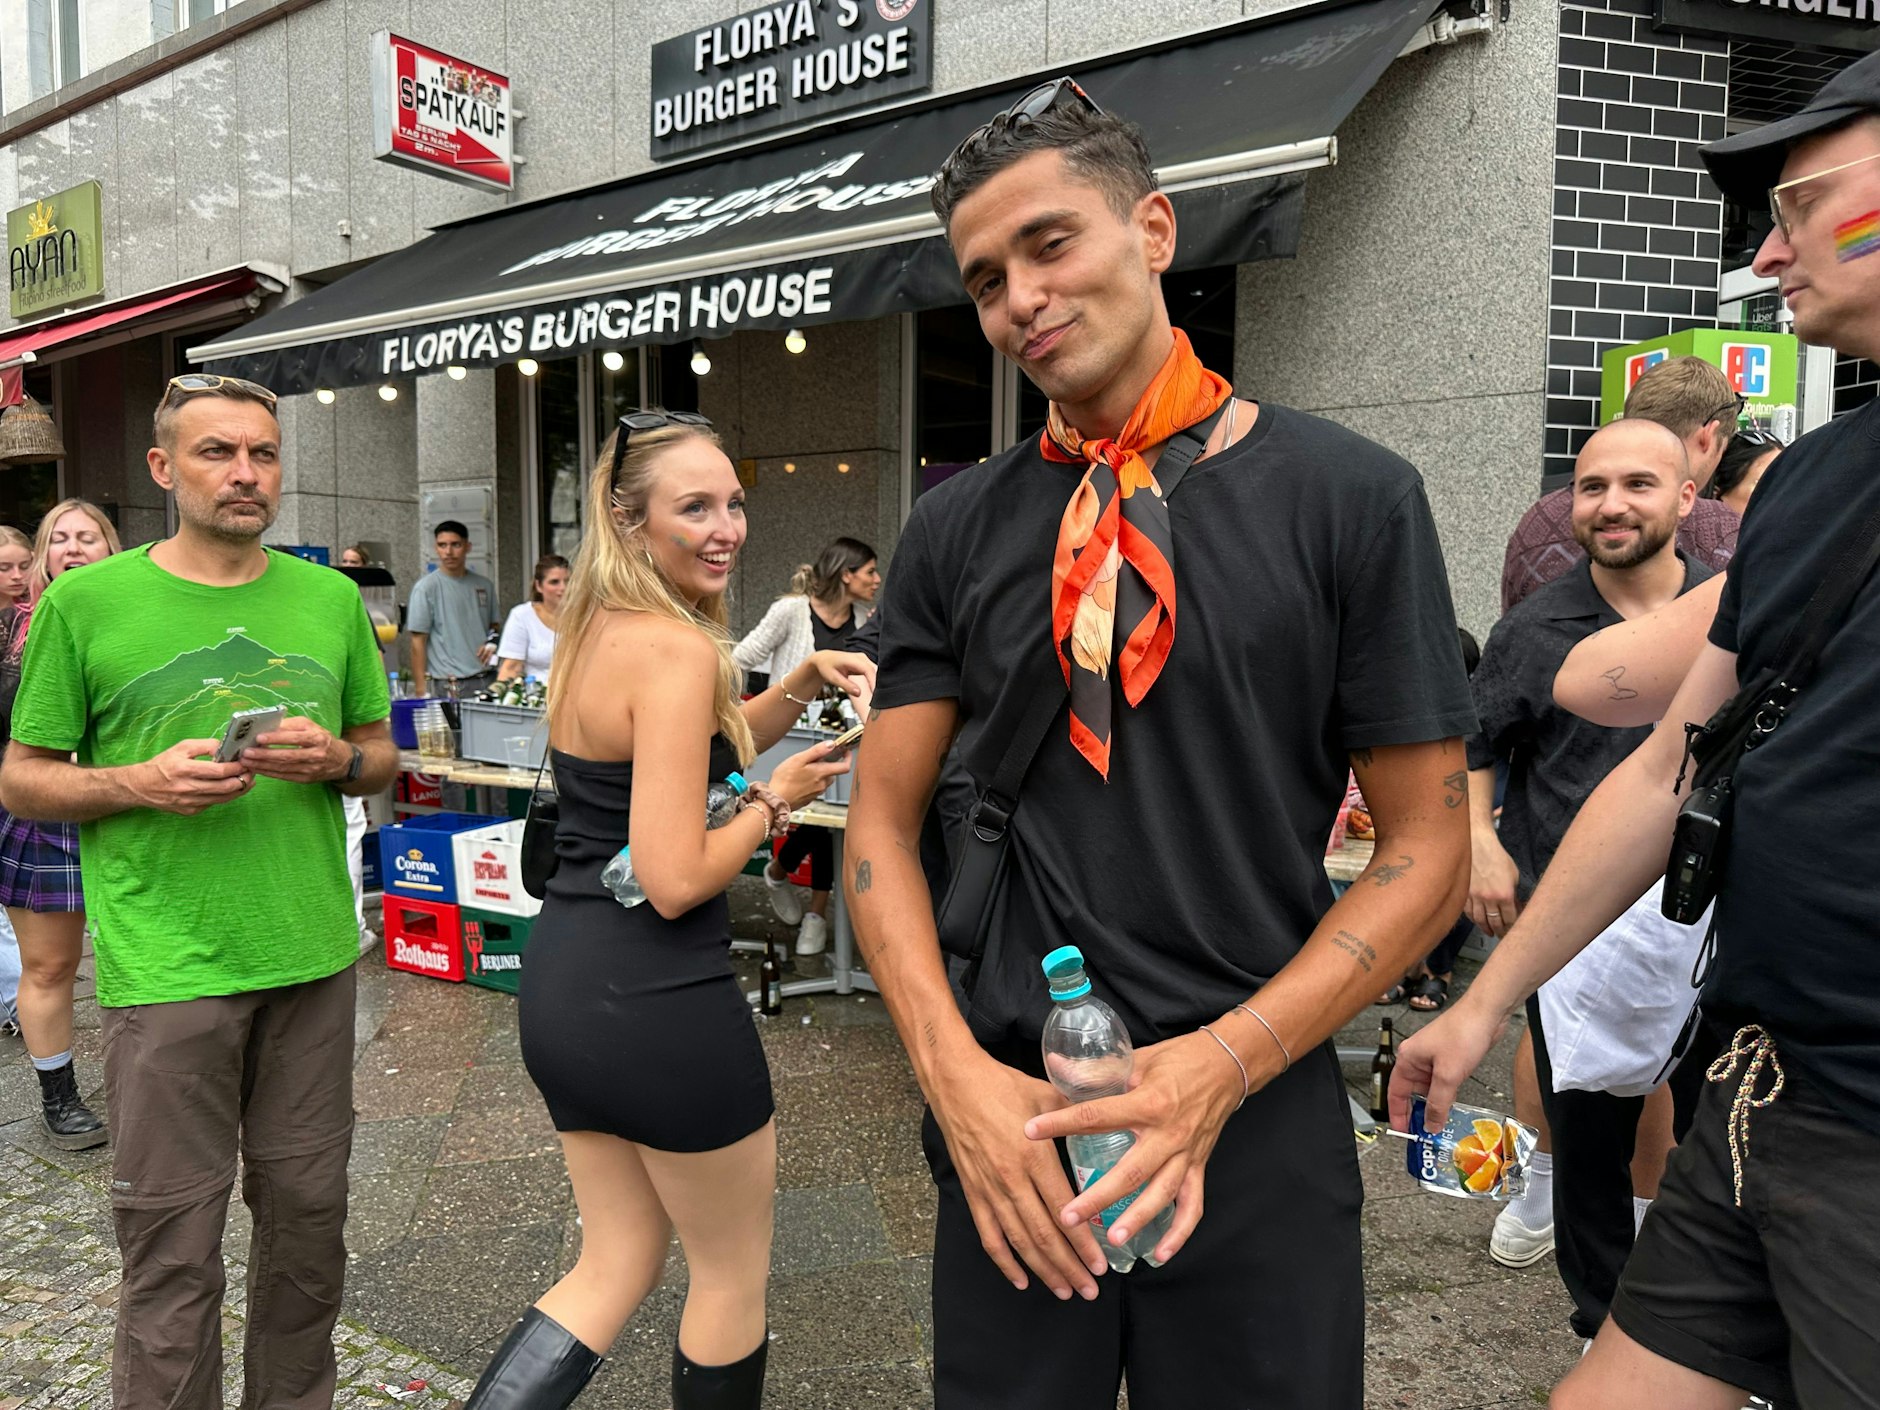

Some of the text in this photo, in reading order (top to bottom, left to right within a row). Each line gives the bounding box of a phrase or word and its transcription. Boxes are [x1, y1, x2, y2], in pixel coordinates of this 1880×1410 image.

[654, 27, 908, 137] BURGER HOUSE
[401, 77, 505, 138] SPÄTKAUF
[400, 126, 461, 151] TAG & NACHT
[415, 124, 448, 140] BERLIN
[10, 229, 77, 291] AYAN
[382, 267, 834, 374] FLORYA'S BURGER HOUSE
[1752, 311, 1774, 324] Uber
[395, 855, 437, 873] Corona
[405, 871, 430, 885] Extra
[393, 936, 450, 972] Rothaus
[480, 953, 522, 972] BERLINER
[1437, 1127, 1455, 1163] ORANGE
